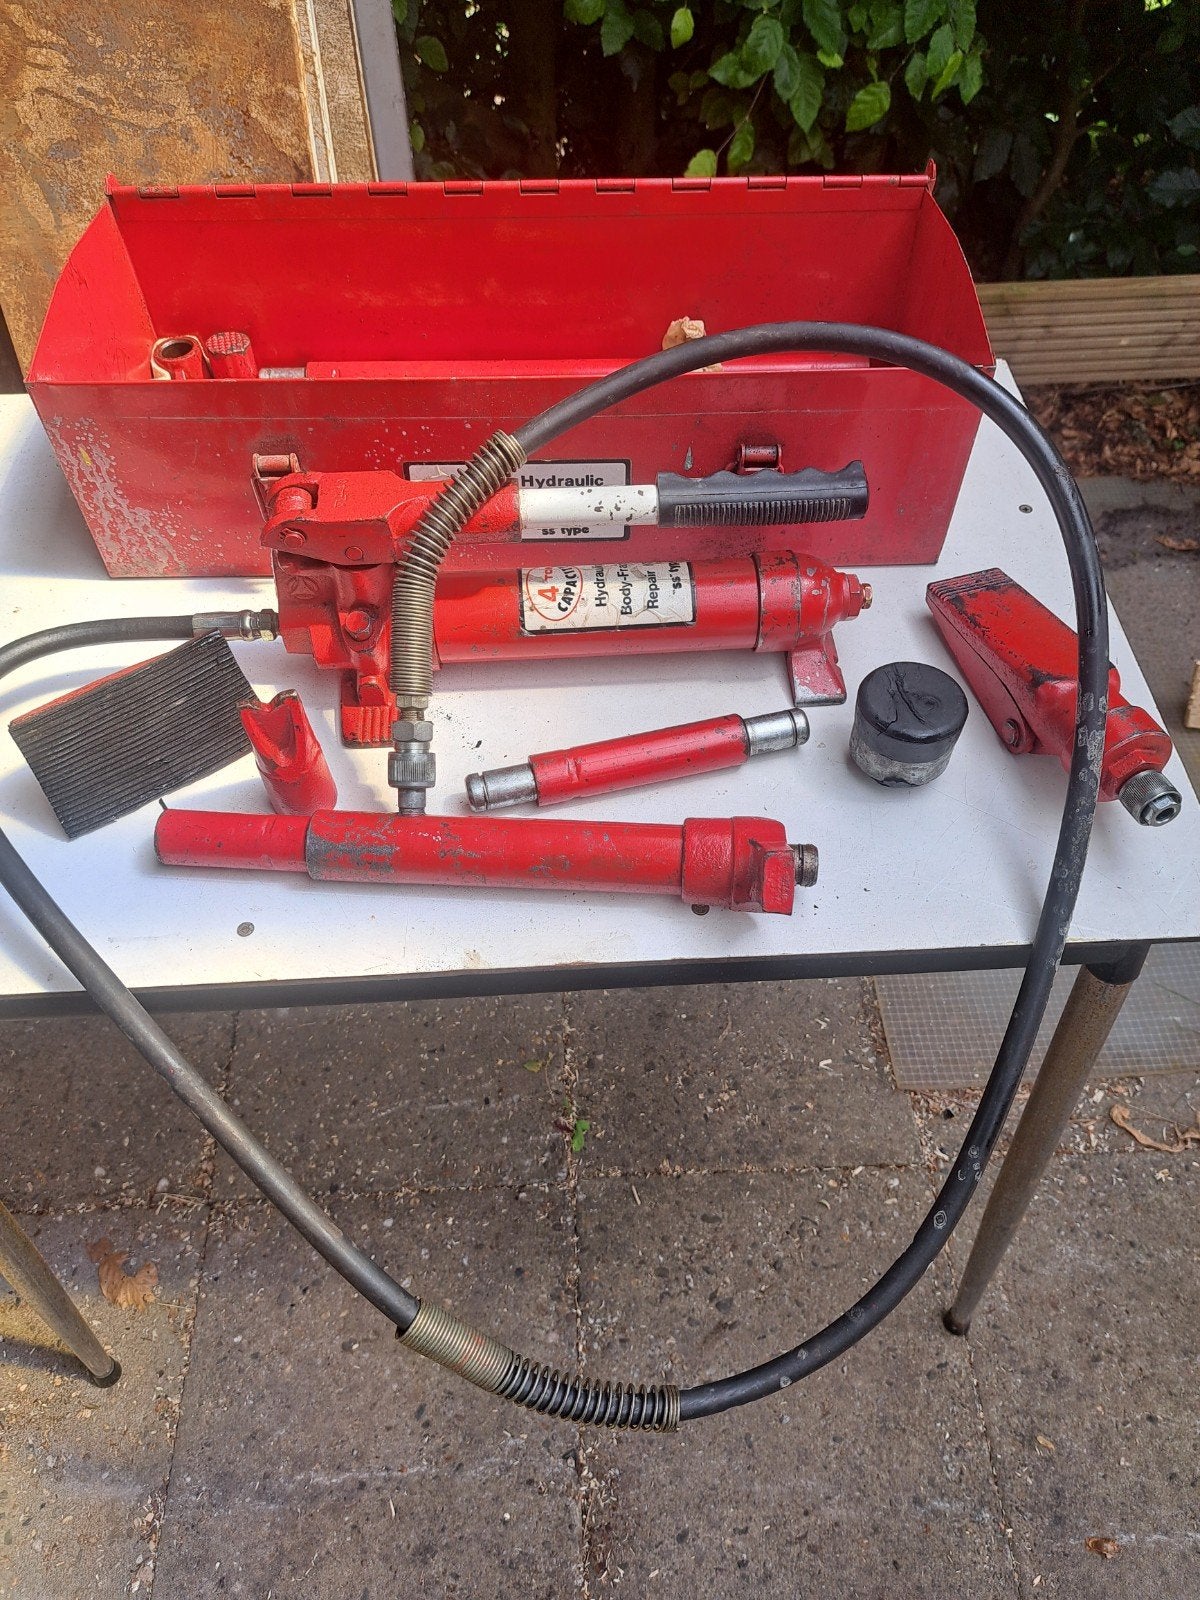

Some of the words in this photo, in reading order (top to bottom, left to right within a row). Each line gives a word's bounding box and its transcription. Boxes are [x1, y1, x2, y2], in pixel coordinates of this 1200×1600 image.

[521, 475, 603, 488] Hydraulic
[538, 586, 559, 601] 4
[558, 567, 577, 612] CAPACIT
[617, 564, 632, 614] Body-Fra
[647, 571, 660, 608] Repair
